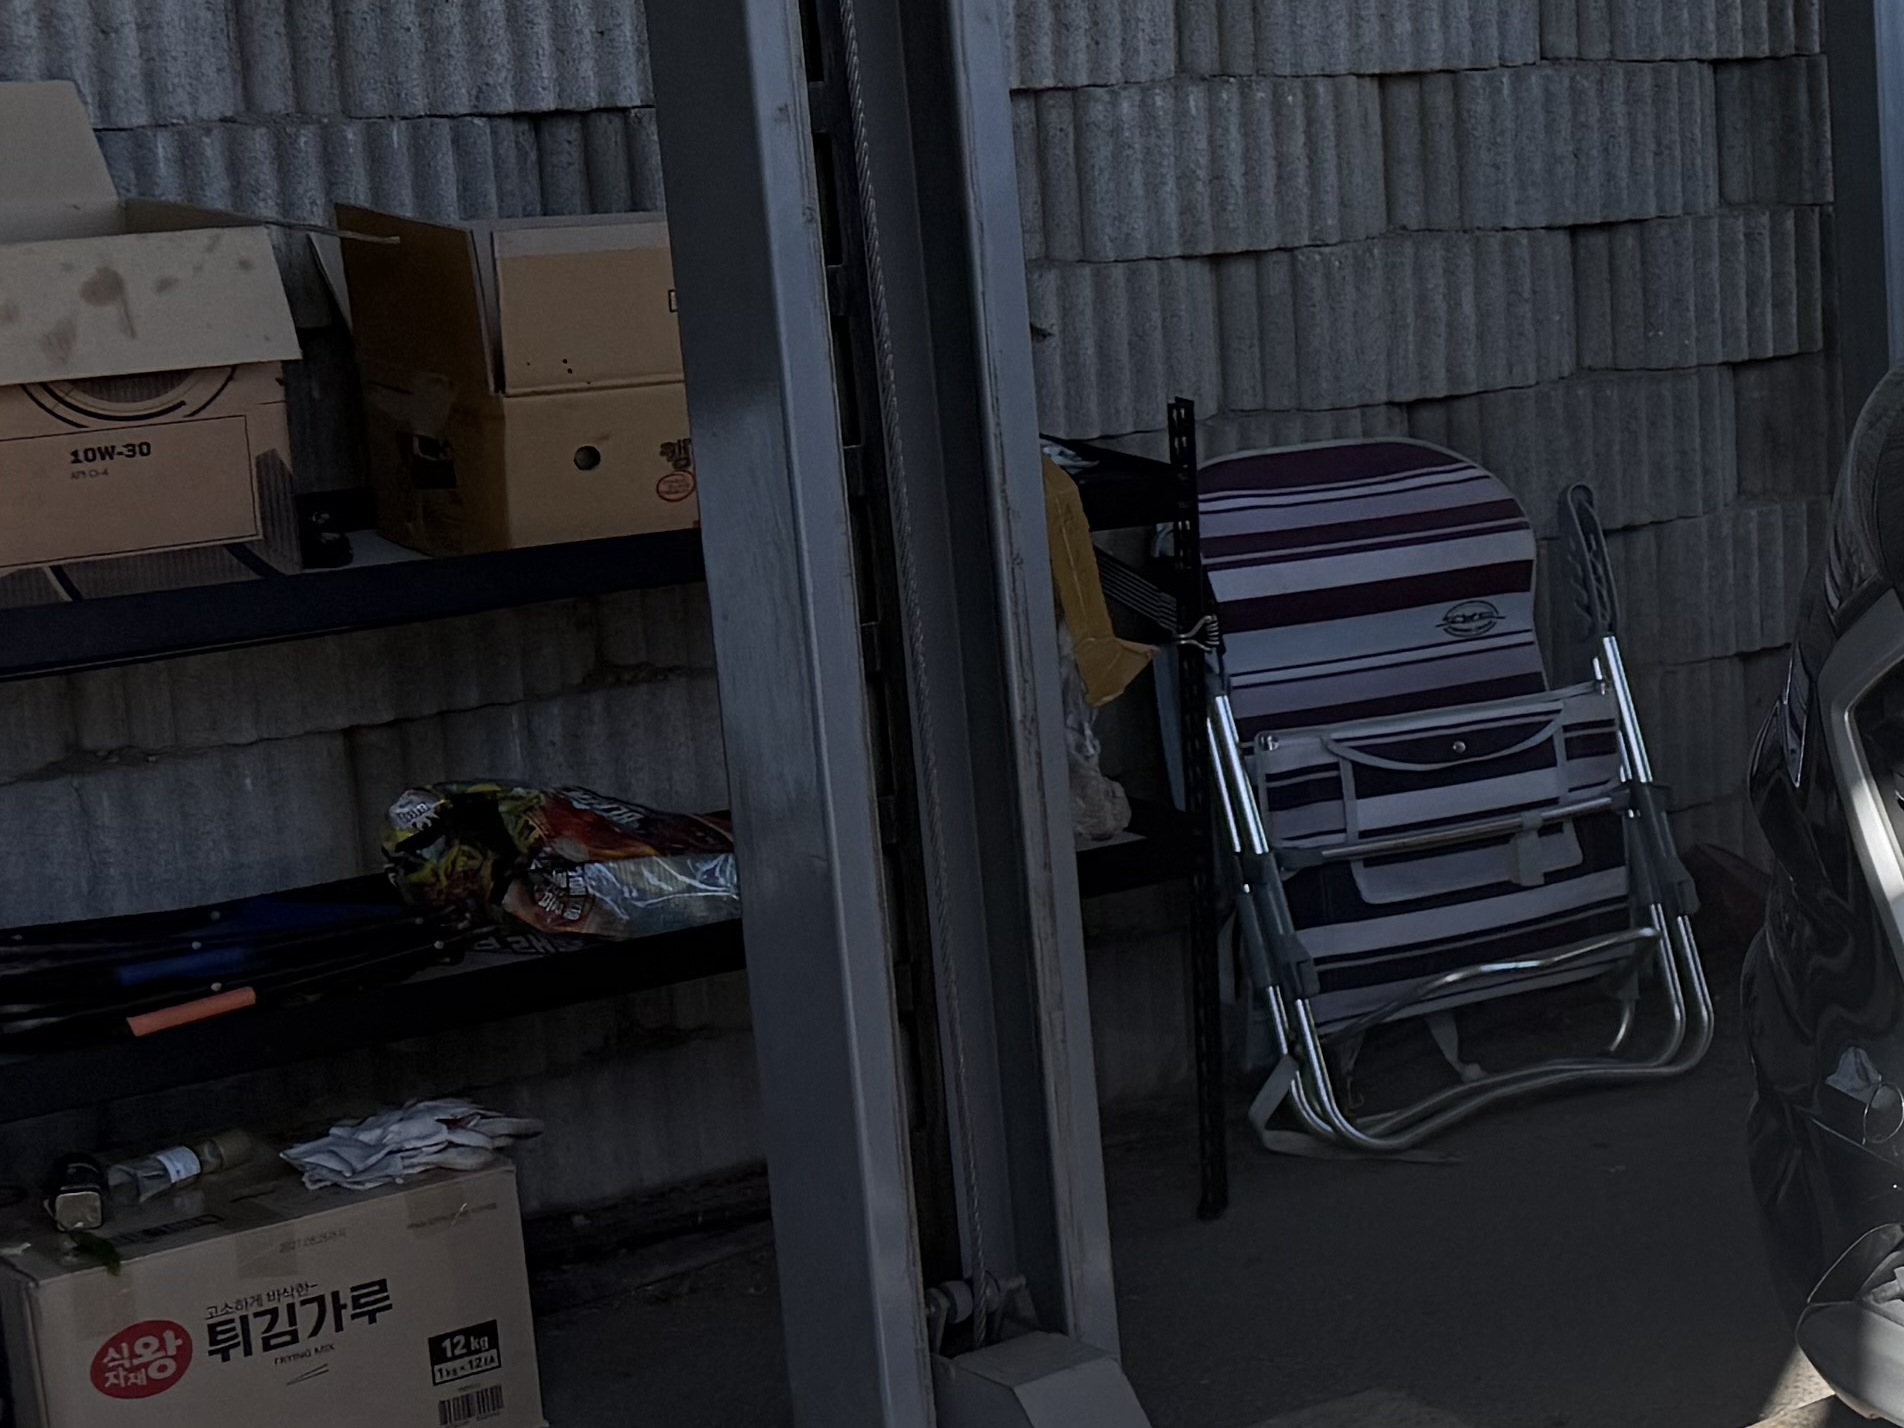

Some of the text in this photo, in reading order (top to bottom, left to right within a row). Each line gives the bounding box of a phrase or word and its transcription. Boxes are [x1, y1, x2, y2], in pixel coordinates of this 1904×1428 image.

[70, 441, 151, 464] 10W-30
[205, 1293, 264, 1320] 고소하게
[206, 1278, 394, 1363] 튀김가루
[441, 1333, 468, 1358] 12
